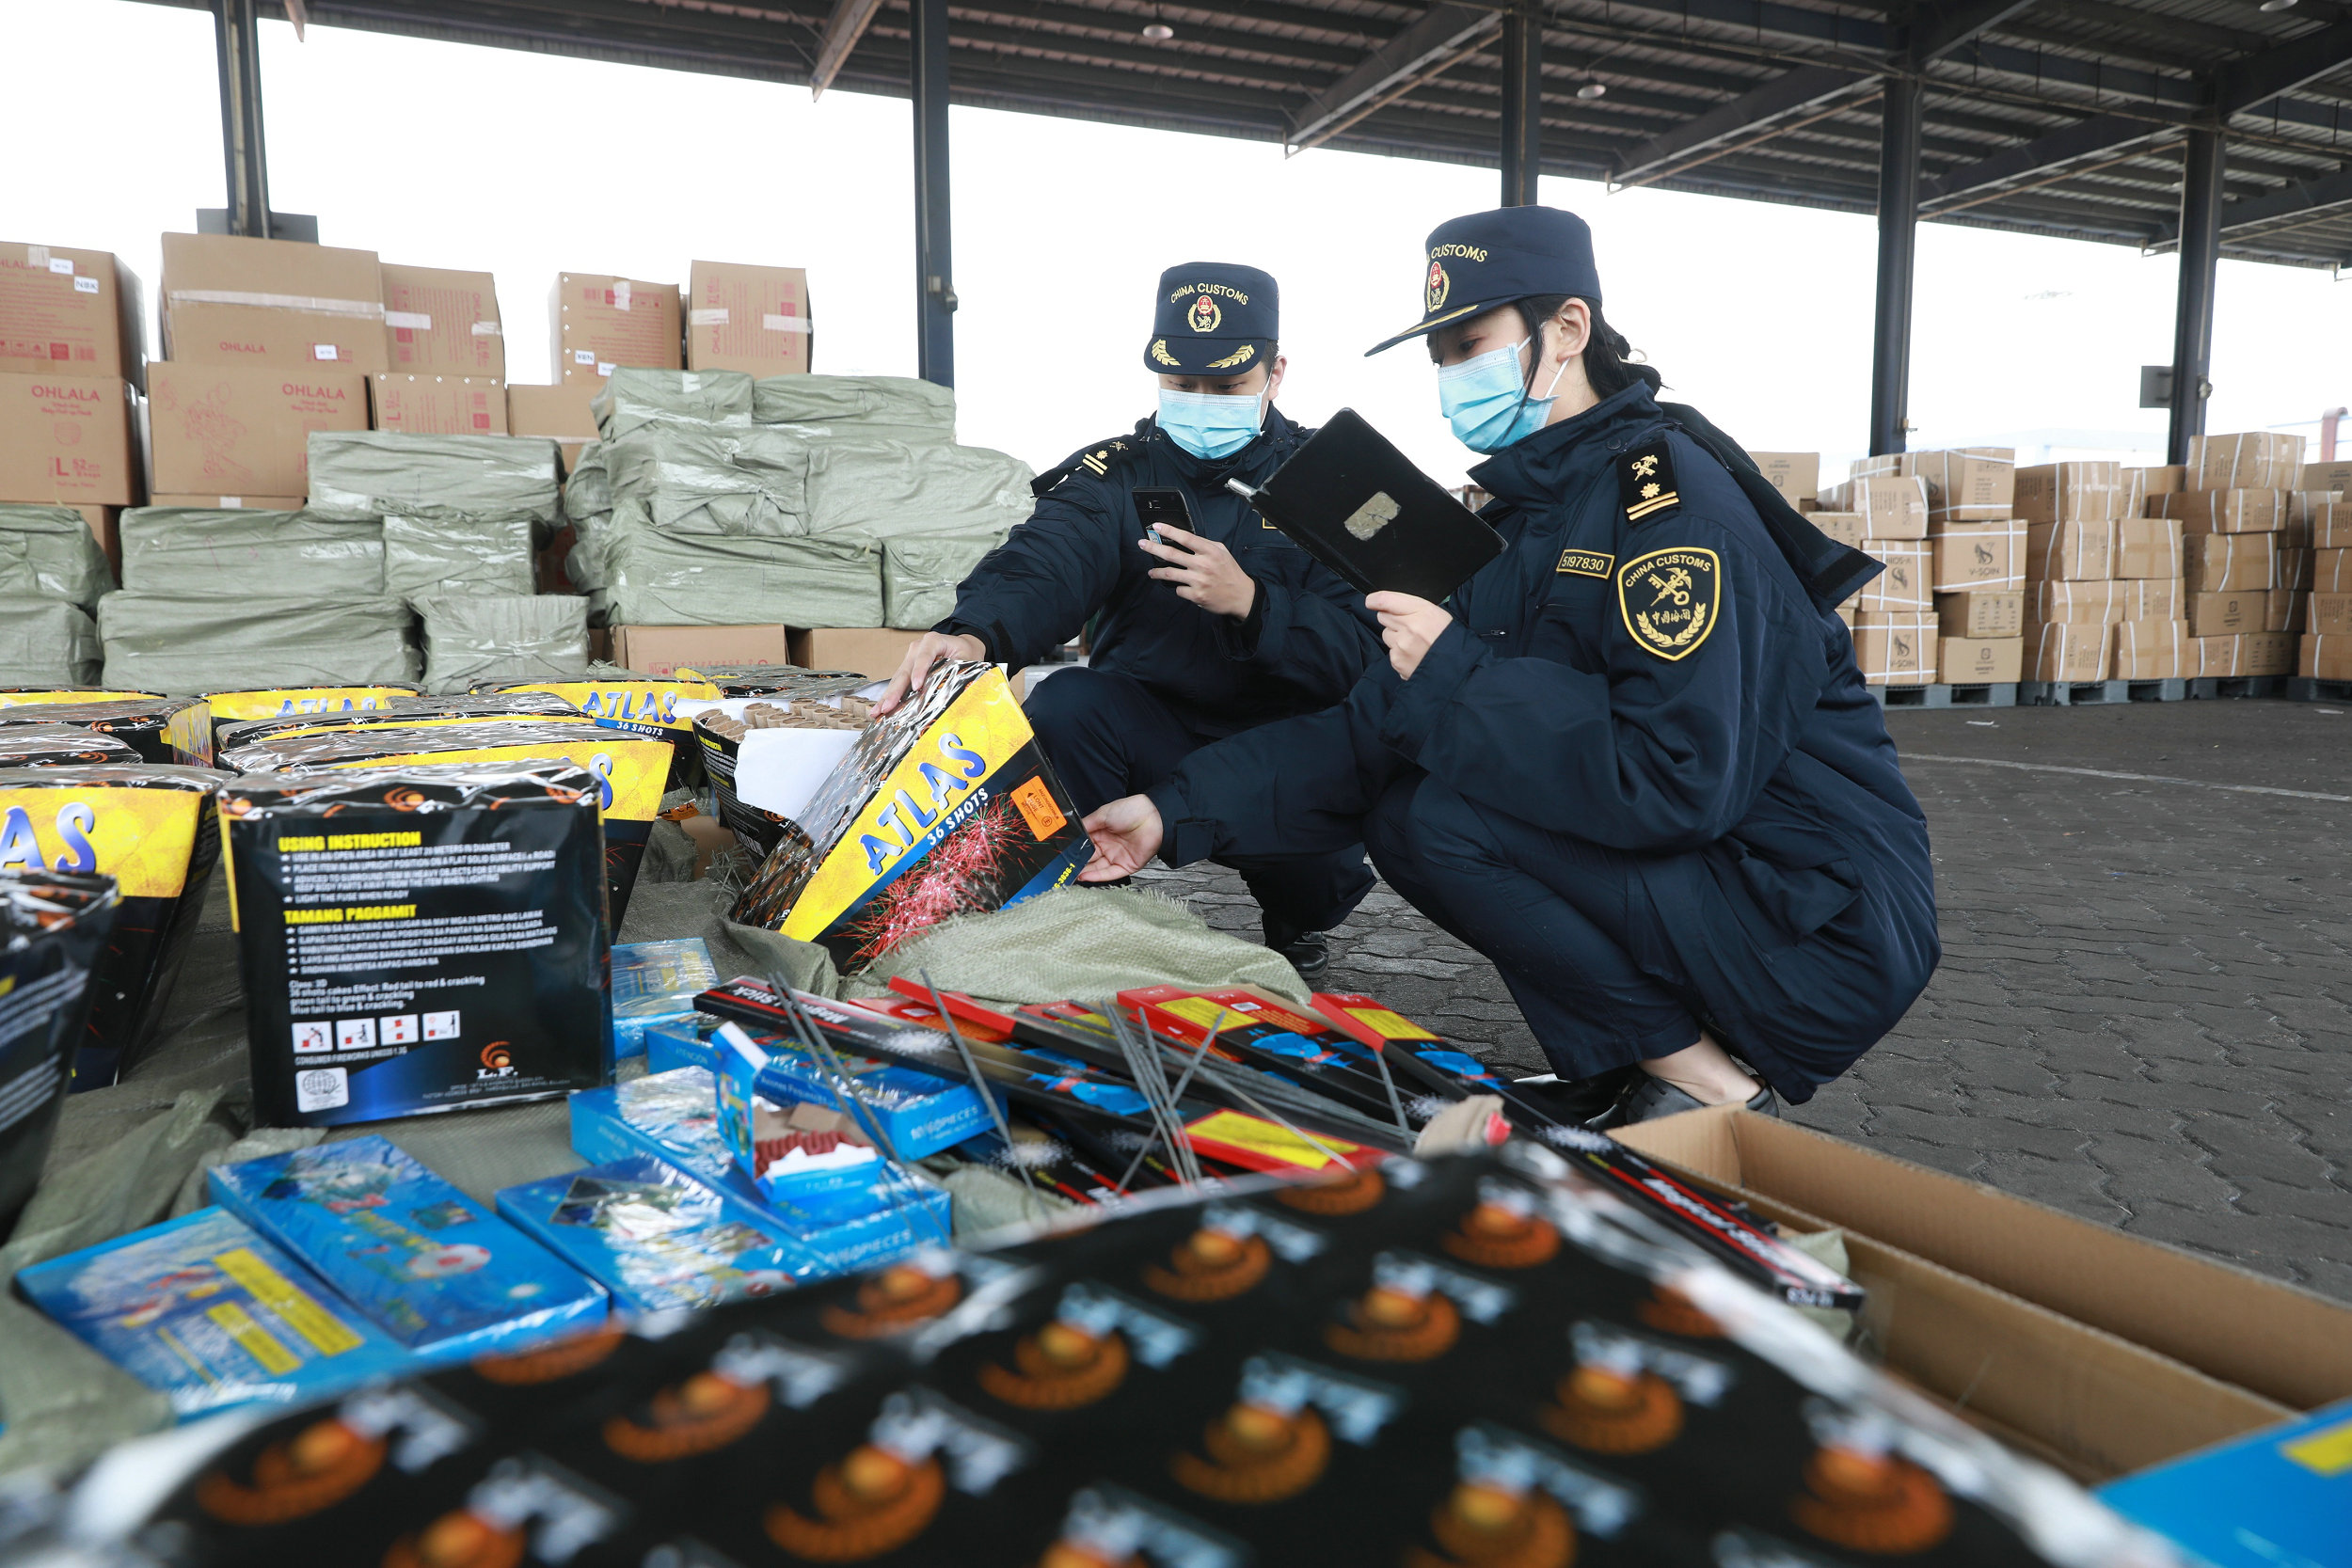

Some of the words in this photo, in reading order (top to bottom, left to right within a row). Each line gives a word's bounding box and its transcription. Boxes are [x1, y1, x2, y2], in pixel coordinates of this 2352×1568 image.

[1431, 244, 1487, 262] CUSTOMS
[1170, 284, 1195, 304] CHINA
[1197, 282, 1249, 306] CUSTOMS
[218, 341, 267, 355] OHLALA
[30, 385, 102, 402] OHLALA
[280, 383, 346, 401] OHLALA
[1561, 555, 1605, 572] 5197830
[1625, 562, 1656, 588] CHINA
[1656, 554, 1711, 573] CUSTOMS
[581, 690, 677, 724] ATLAS
[616, 721, 629, 731] 36
[630, 723, 664, 736] SHOTS
[859, 733, 987, 876] ATLAS
[1033, 794, 1045, 809] LONT
[927, 827, 946, 847] 36
[945, 787, 989, 830] SHOTS
[278, 835, 326, 852] USING
[327, 831, 421, 850] INSTRUCTION
[356, 849, 377, 860] AREA
[399, 847, 423, 857] LEAST
[473, 842, 511, 852] DIAMETER
[293, 863, 318, 873] PLACE
[394, 857, 430, 868] POSITION
[430, 857, 442, 866] ON
[449, 855, 467, 865] FLAT
[468, 854, 488, 864] SOLID
[414, 869, 437, 879] HEAVY
[439, 866, 471, 877] OBJECTS
[472, 866, 487, 875] FOR
[523, 861, 556, 871] SUPPORT
[294, 895, 319, 904] LIGHT
[320, 894, 336, 902] THE
[283, 908, 343, 925] TAMANG
[345, 904, 417, 922] PAGGAMIT
[301, 988, 326, 997] shots
[328, 986, 352, 995] cakes
[383, 982, 399, 991] Red
[400, 981, 414, 990] tail
[425, 979, 439, 988] red
[439, 978, 447, 987] &
[447, 975, 485, 987] crackling
[290, 998, 314, 1008] green
[315, 995, 330, 1006] tail
[330, 995, 342, 1004] to
[342, 994, 366, 1005] green
[368, 992, 375, 1002] &
[375, 990, 415, 1003] crackling
[732, 986, 779, 1006] Stick
[291, 1005, 310, 1015] blue
[310, 1004, 326, 1014] tail
[326, 1004, 337, 1012] to
[338, 1002, 356, 1012] blue
[357, 1001, 363, 1010] &
[294, 1053, 332, 1067] CONSUMER
[332, 1052, 371, 1064] FIREWORKS
[477, 1066, 519, 1080] L.F.
